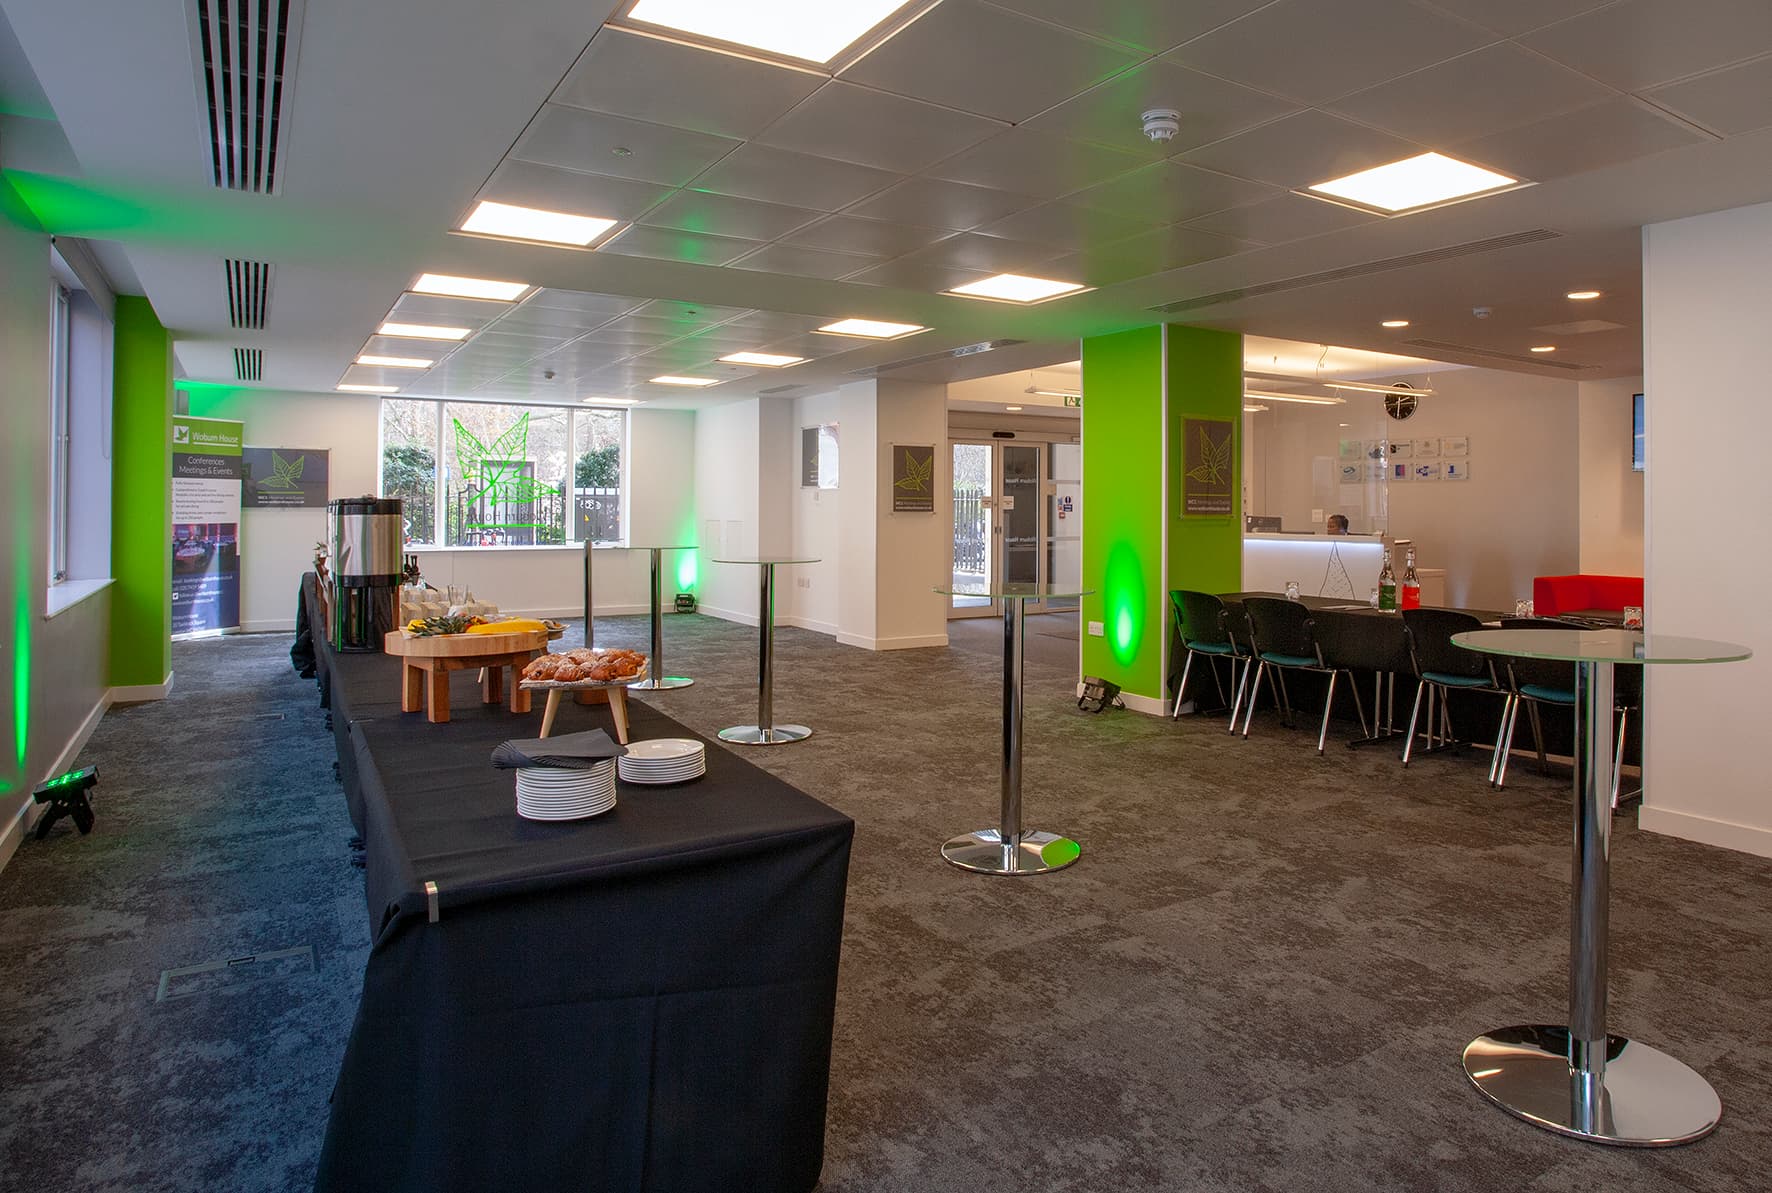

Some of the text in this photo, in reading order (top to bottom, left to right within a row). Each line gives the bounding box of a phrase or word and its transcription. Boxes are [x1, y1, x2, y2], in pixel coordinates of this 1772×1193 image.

[192, 432, 239, 443] Woburn House
[187, 456, 225, 466] Conferences
[178, 465, 207, 475] Meetings
[213, 466, 233, 475] Events
